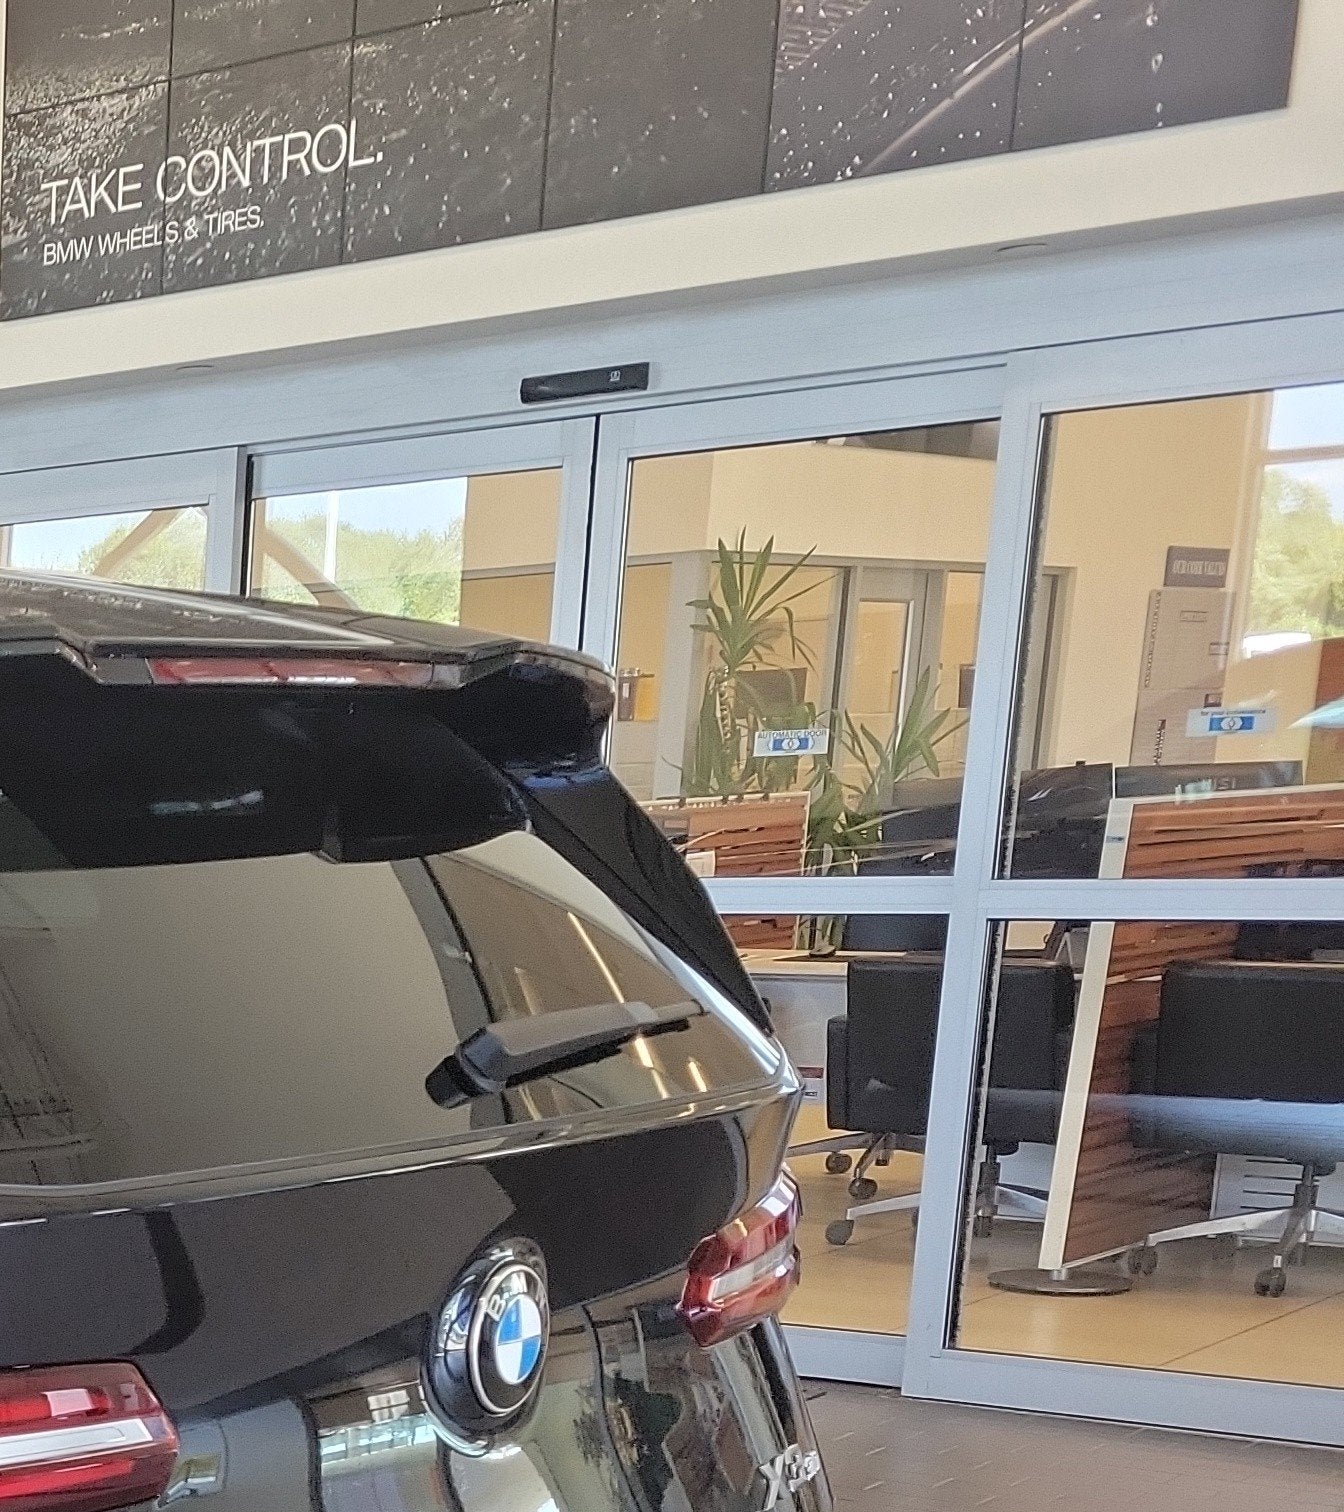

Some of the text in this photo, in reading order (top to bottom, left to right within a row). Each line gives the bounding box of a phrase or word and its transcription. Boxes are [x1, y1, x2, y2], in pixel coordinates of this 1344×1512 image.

[41, 117, 384, 226] TAKE CONTROL.
[43, 235, 94, 266] BMW
[98, 221, 179, 257] WHEELS
[184, 215, 199, 241] &
